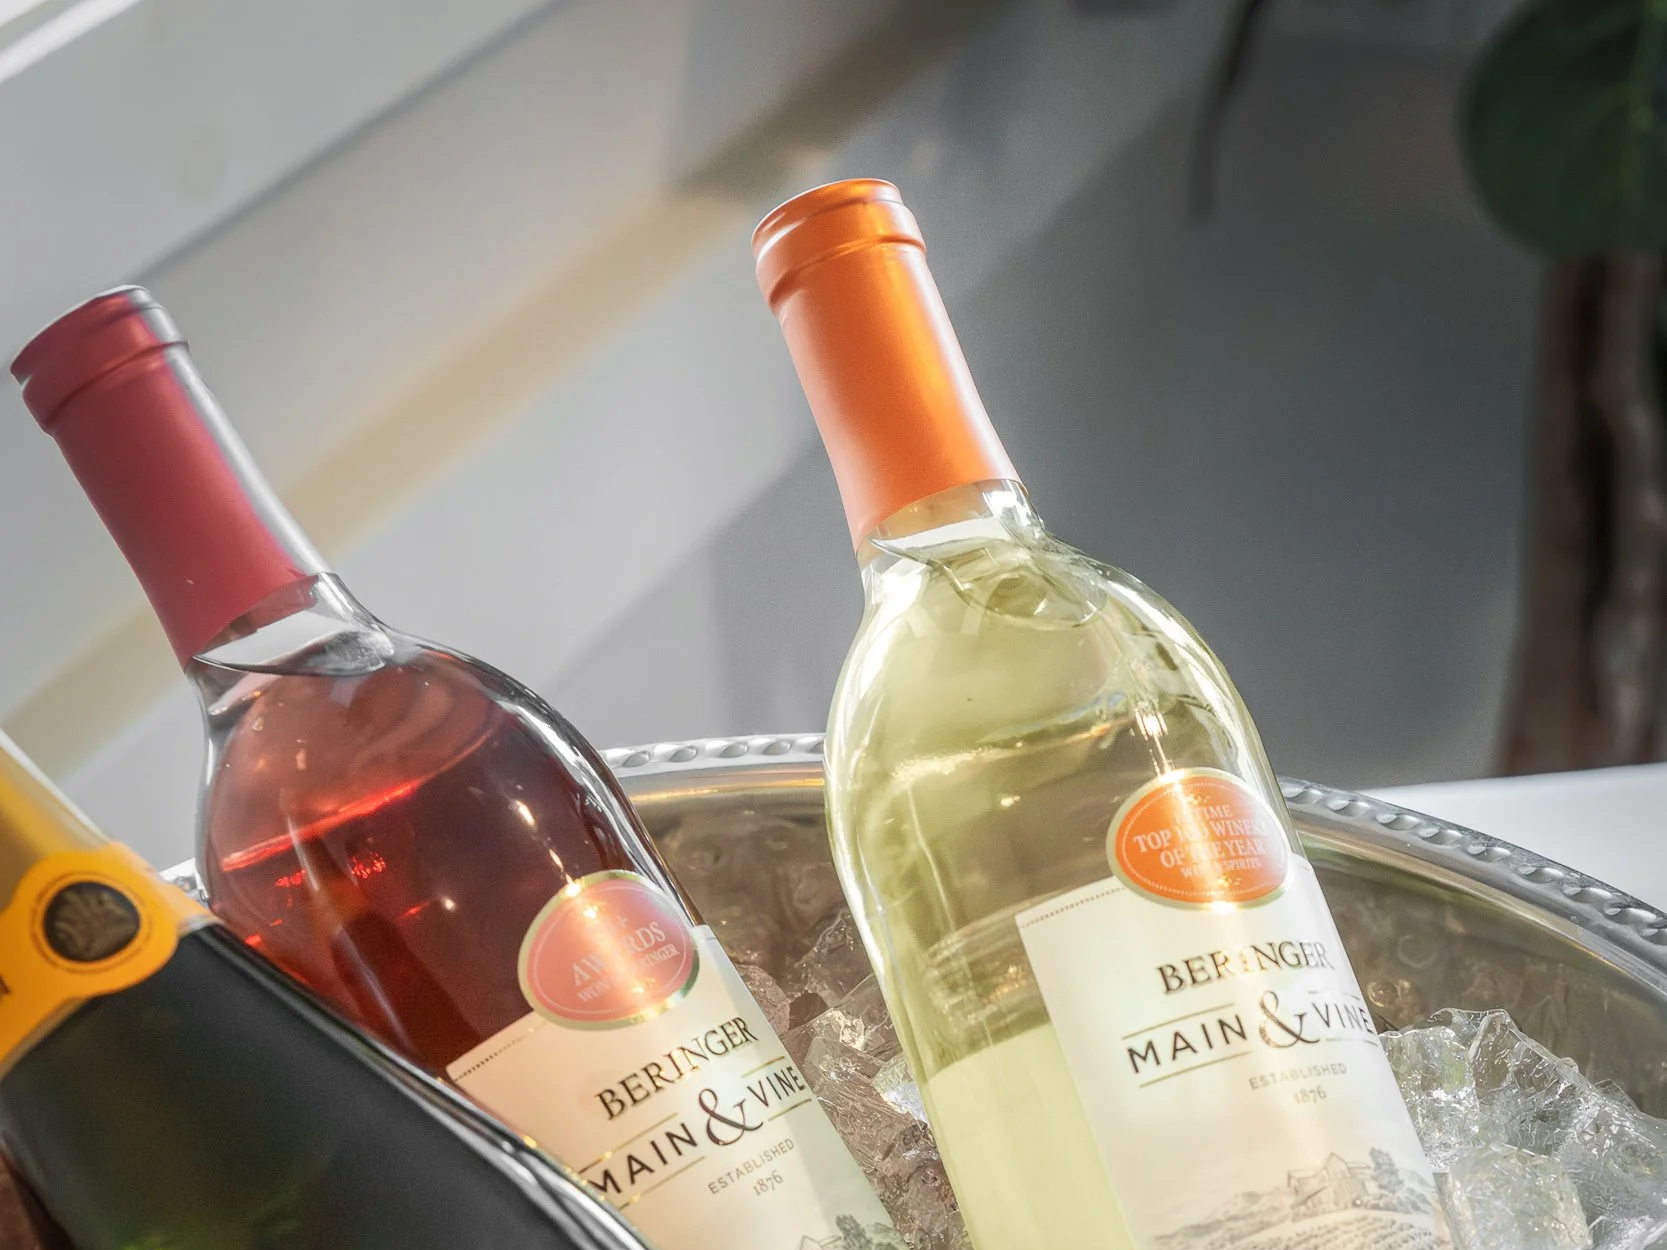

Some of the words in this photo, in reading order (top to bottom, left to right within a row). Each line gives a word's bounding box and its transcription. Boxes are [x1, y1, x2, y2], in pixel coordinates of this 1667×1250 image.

[1133, 829, 1172, 853] TOP
[1160, 848, 1186, 868] OF
[1224, 838, 1267, 857] YEAR
[572, 921, 667, 987] AWRDS
[1156, 940, 1335, 995] BERINGER
[1126, 1013, 1249, 1076] MAIN
[1258, 990, 1321, 1049] &
[1312, 1001, 1376, 1036] VINE
[594, 1015, 760, 1121] BERINGER
[1248, 1062, 1348, 1090] ESTABLISHED
[1293, 1084, 1328, 1105] 1876
[588, 1122, 699, 1194] MAIN
[698, 1088, 764, 1147] &
[746, 1065, 806, 1108] VINE
[707, 1137, 795, 1195] ESTABLISHED
[752, 1168, 785, 1196] 1876
